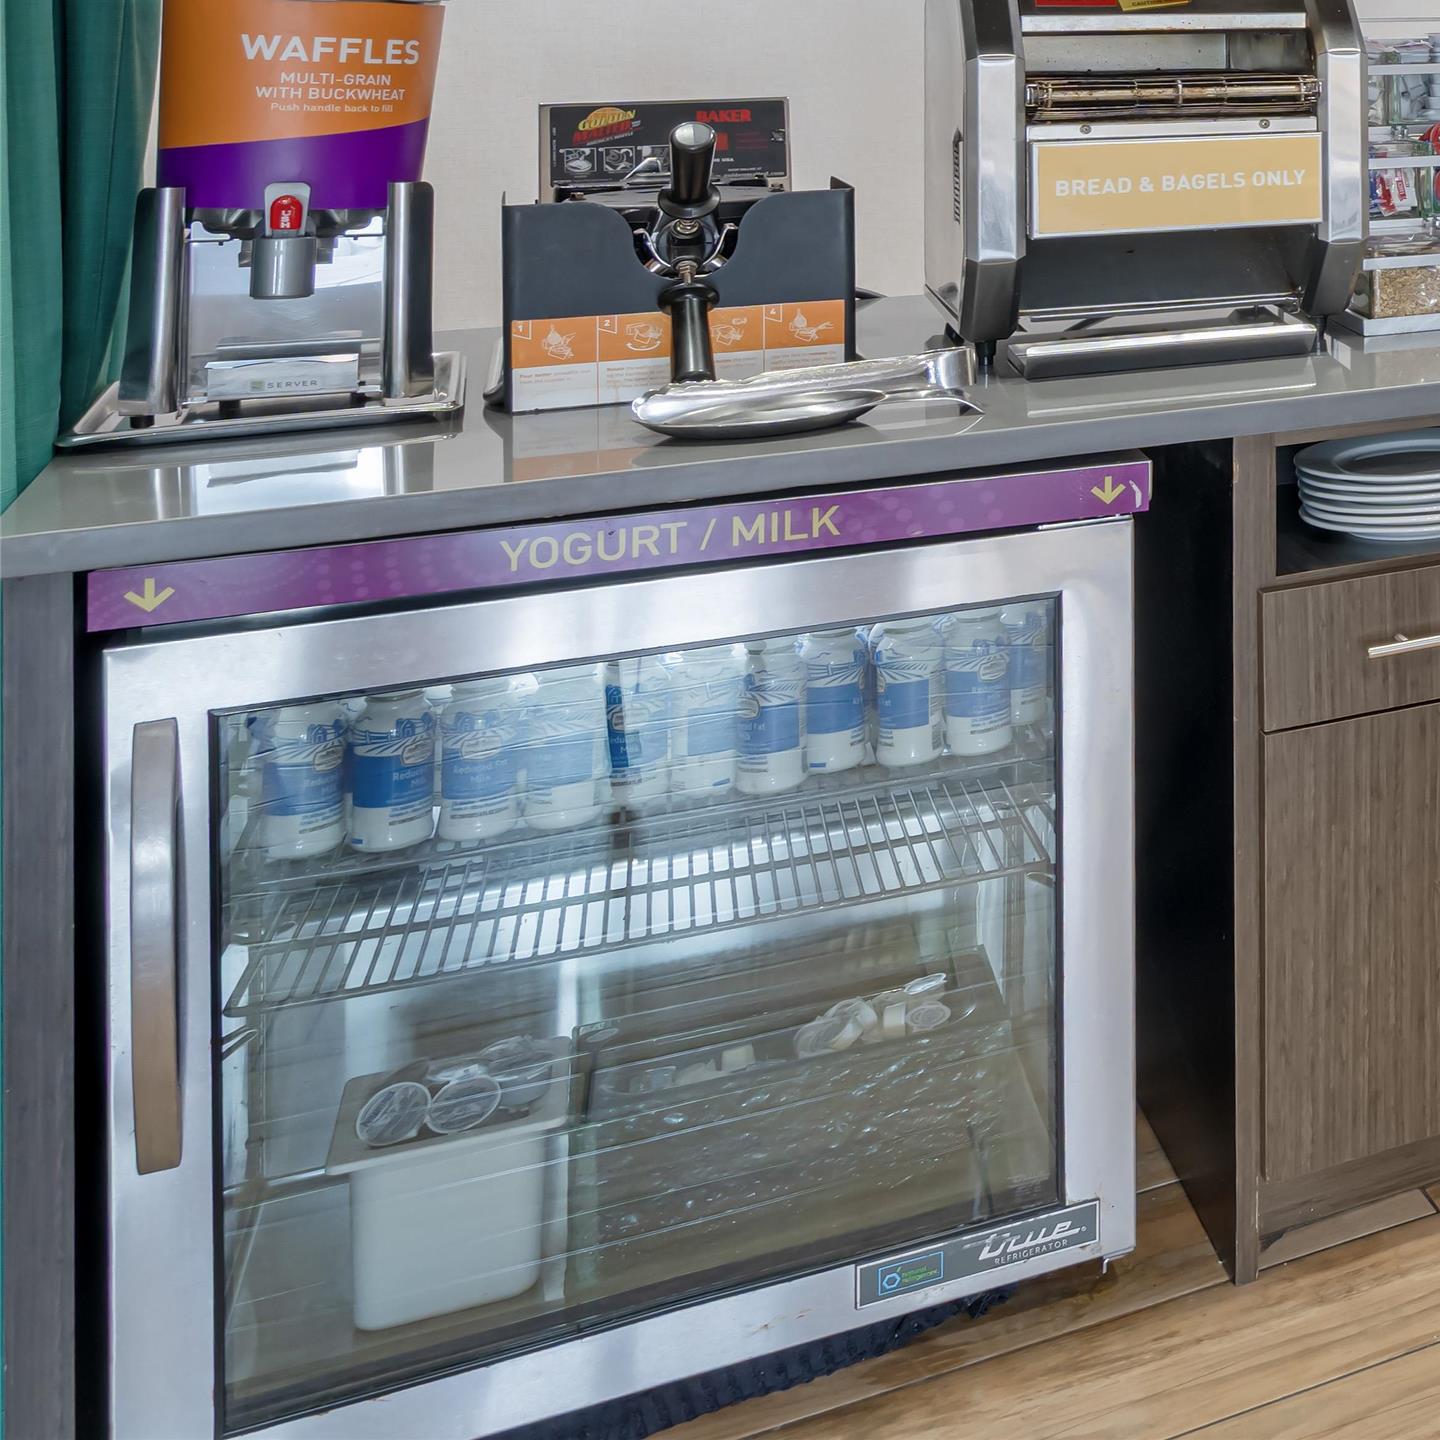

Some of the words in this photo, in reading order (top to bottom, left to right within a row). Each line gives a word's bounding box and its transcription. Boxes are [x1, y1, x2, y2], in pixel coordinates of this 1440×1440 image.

[241, 33, 420, 66] WAFFLES
[280, 71, 392, 86] MULTI-GRAIN
[255, 86, 302, 100] WITH
[308, 87, 406, 102] BUCKWHEAT
[270, 102, 300, 112] Push
[303, 103, 341, 113] handle
[344, 104, 368, 113] back
[370, 104, 380, 113] to
[382, 104, 394, 113] fill
[578, 109, 636, 131] GOLDEN
[696, 109, 752, 122] BAKER
[1055, 176, 1132, 197] BREAD
[1139, 176, 1154, 192] &
[1161, 171, 1246, 192] BAGELS
[1252, 168, 1306, 187] ONLY
[770, 308, 777, 316] 4
[518, 324, 523, 332] 1
[604, 318, 610, 327] 2
[267, 380, 318, 389] SERVER
[500, 520, 688, 572] YOGURT
[700, 518, 717, 551] /
[731, 505, 841, 547] MILK
[994, 1238, 1068, 1265] REFRIGERATOR
